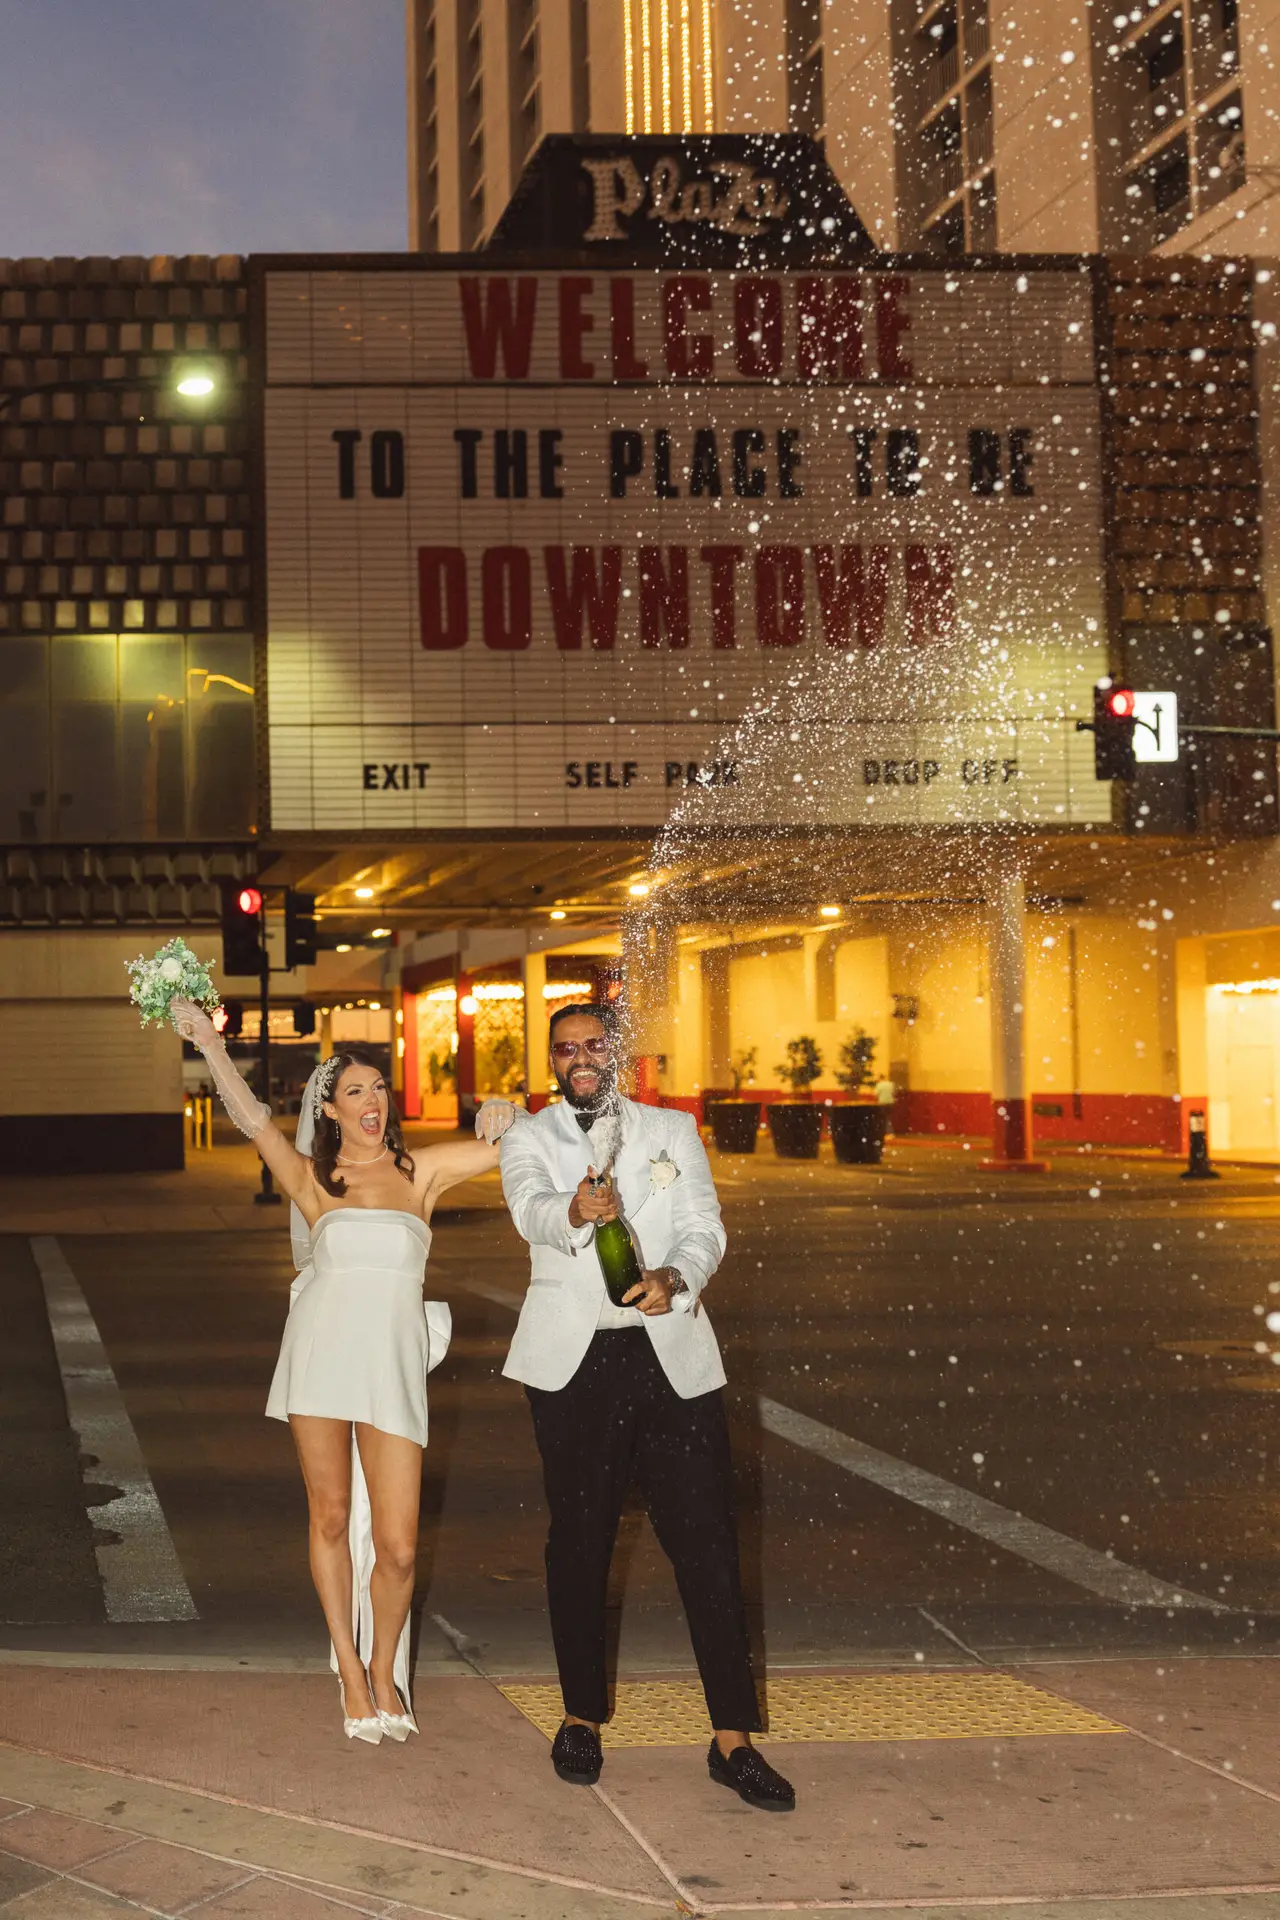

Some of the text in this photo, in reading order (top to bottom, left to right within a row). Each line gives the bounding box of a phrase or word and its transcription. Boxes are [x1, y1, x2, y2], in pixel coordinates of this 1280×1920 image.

[460, 275, 914, 379] WELCOME
[332, 429, 405, 499] TO
[453, 429, 565, 498] THE
[610, 428, 802, 499] PLACE
[852, 427, 920, 497] TO
[418, 544, 958, 651] DOWNTOWN
[362, 763, 431, 790] EXIT
[565, 762, 638, 789] SELF
[863, 758, 942, 786] DROP
